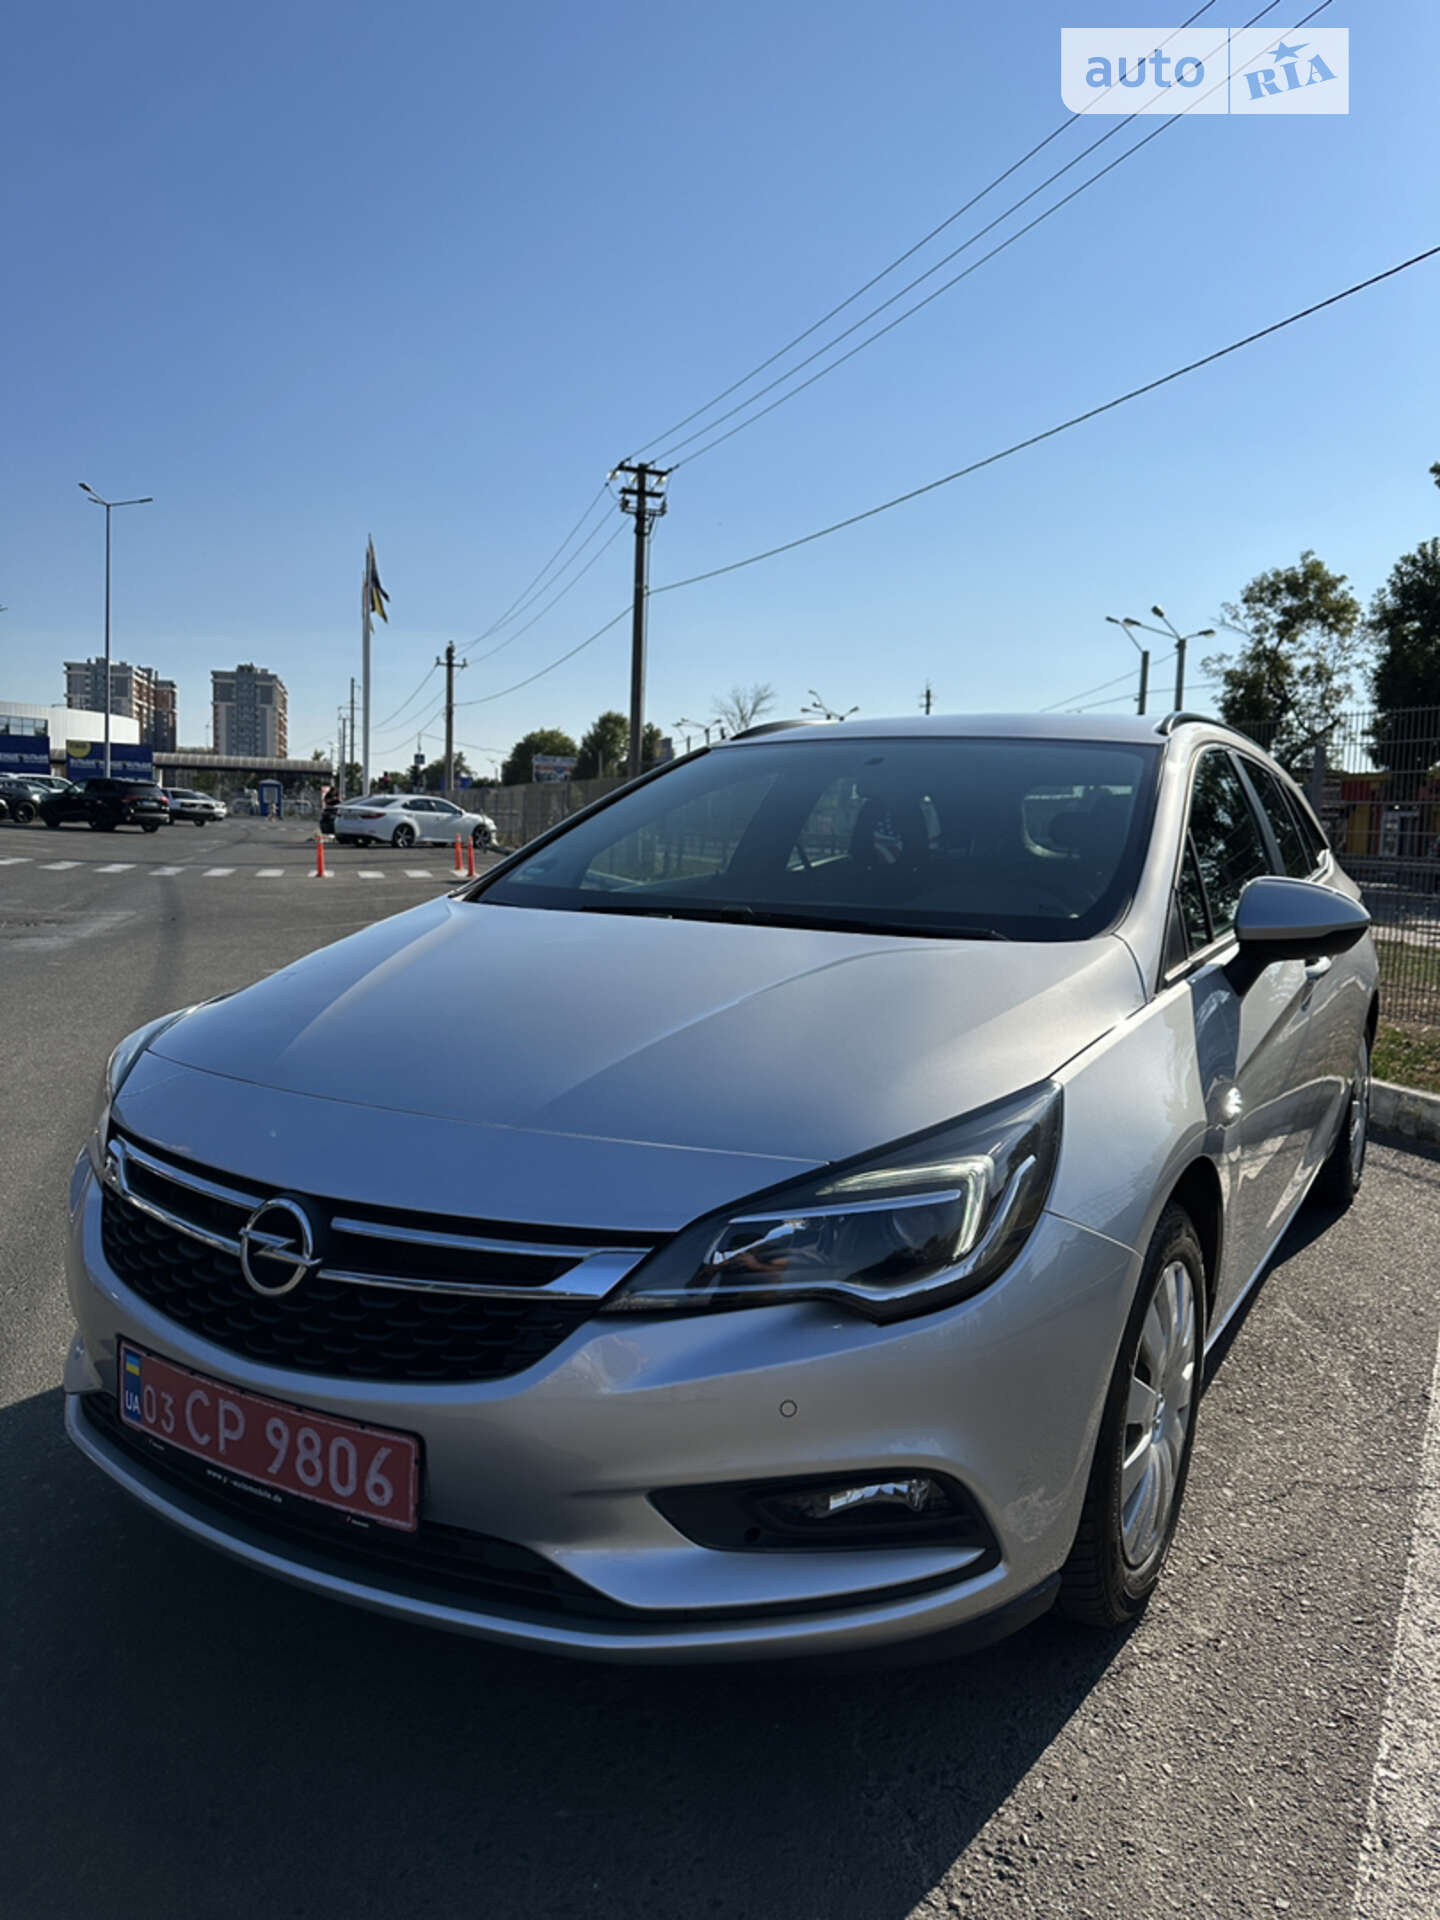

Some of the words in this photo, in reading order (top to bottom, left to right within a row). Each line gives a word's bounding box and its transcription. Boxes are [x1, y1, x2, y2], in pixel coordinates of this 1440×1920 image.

[125, 1389, 141, 1415] UA
[143, 1385, 175, 1433] 03
[185, 1389, 246, 1454] CP
[265, 1418, 393, 1508] 9806
